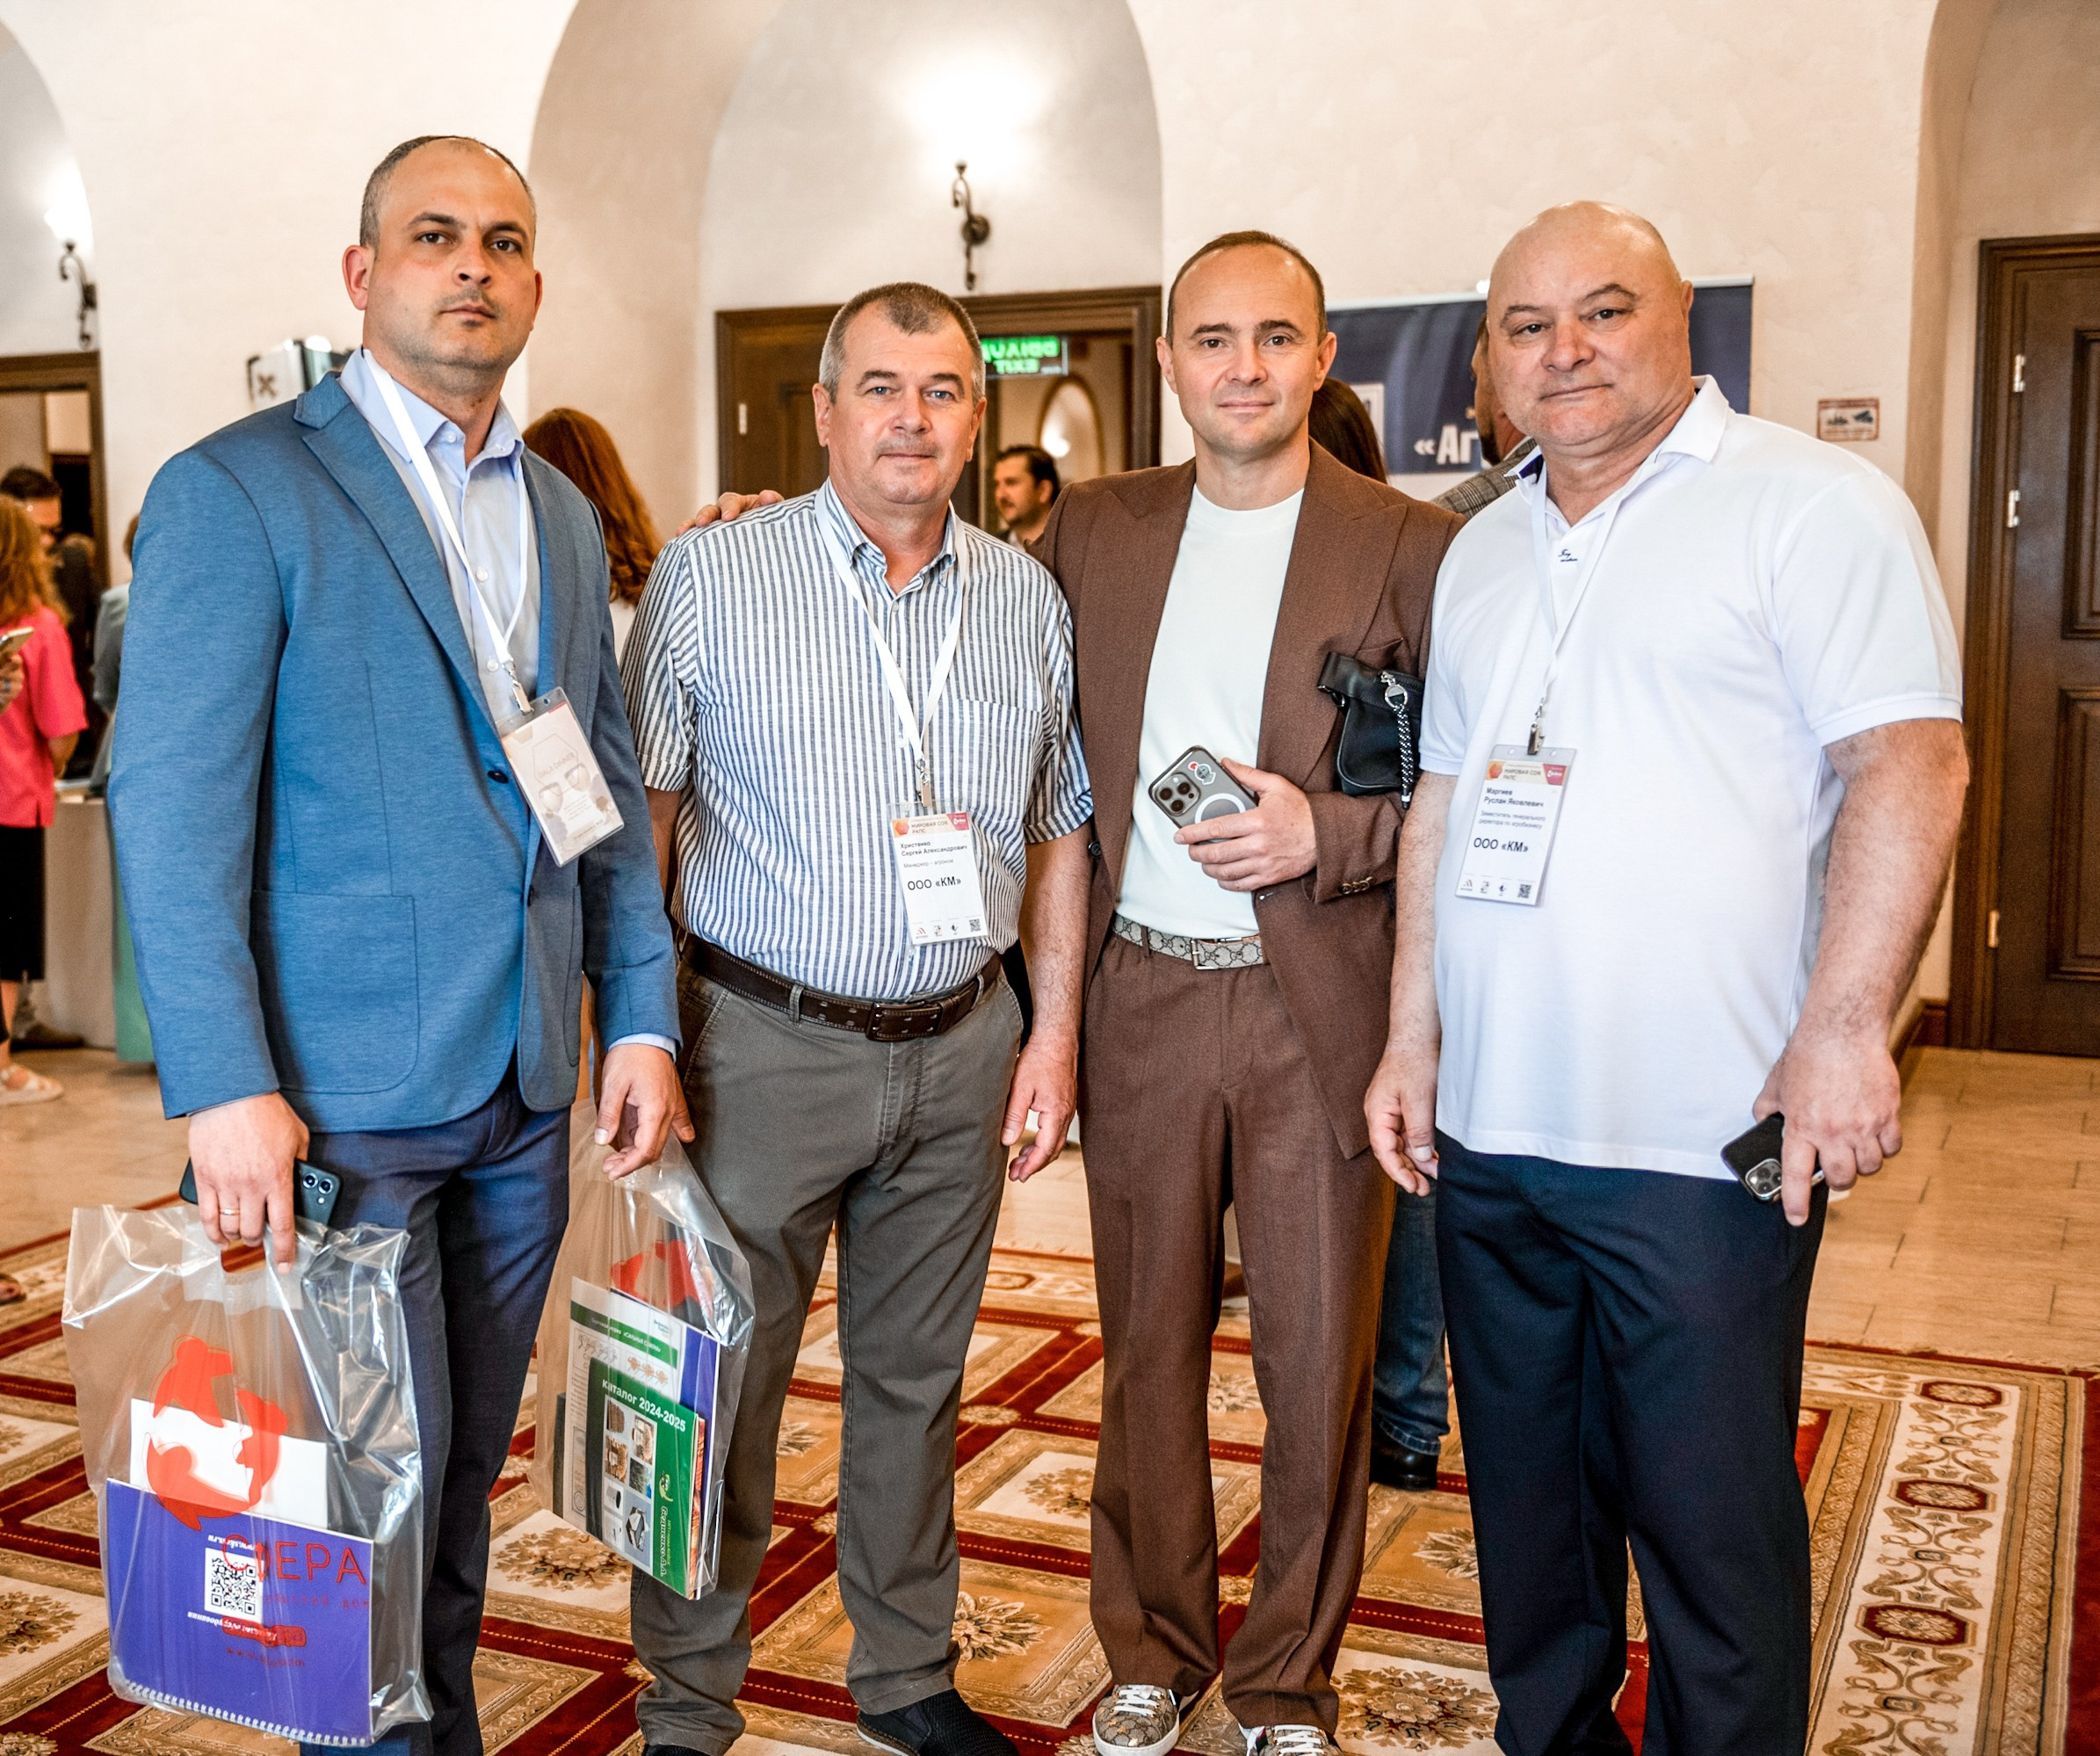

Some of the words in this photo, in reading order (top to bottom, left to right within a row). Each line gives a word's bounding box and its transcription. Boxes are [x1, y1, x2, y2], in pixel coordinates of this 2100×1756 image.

[1484, 796, 1506, 805] Руслан
[1507, 798, 1544, 807] Яковлевич
[900, 841, 931, 850] Христенко
[923, 845, 967, 854] Александрович
[1474, 838, 1498, 850] ООО
[1502, 840, 1529, 853] «КМ»
[908, 879, 932, 890] ООО
[936, 876, 961, 888] «КМ»
[639, 1396, 685, 1433] 2024-2025
